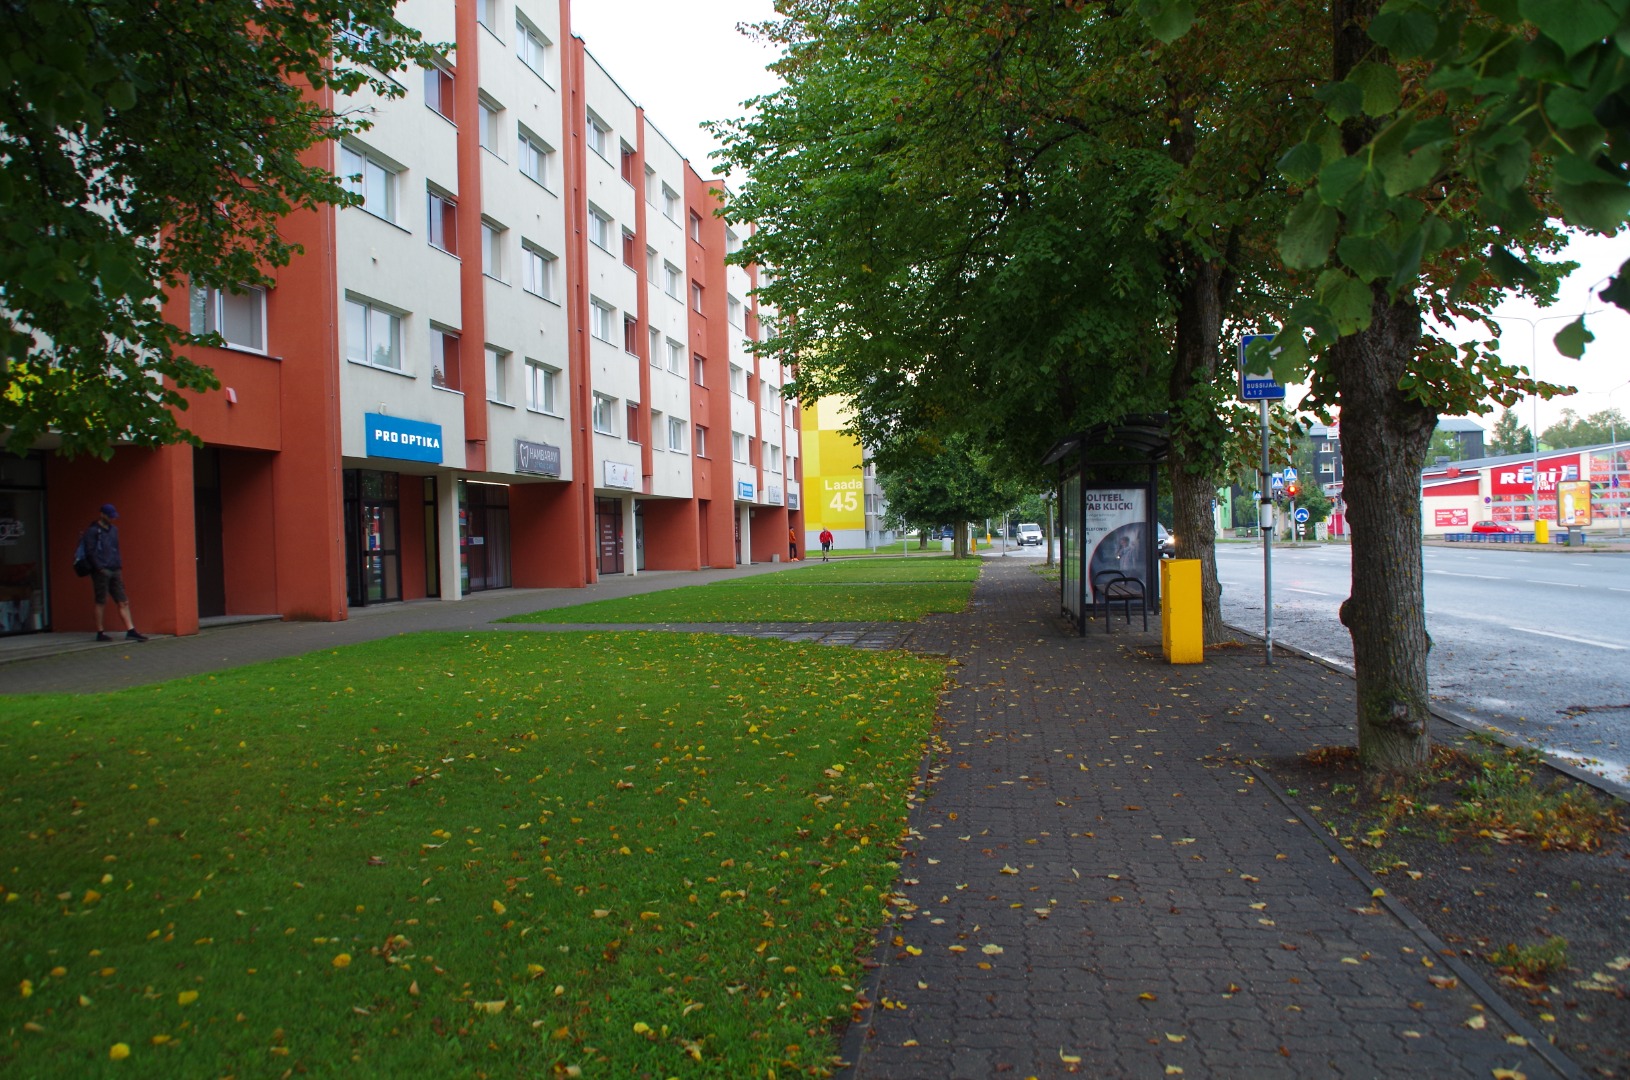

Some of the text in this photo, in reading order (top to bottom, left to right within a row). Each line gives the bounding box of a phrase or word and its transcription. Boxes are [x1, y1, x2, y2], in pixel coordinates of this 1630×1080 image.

[375, 429, 440, 449] PRO OPTIKA
[824, 479, 863, 491] Laada
[829, 491, 858, 512] 45
[1103, 502, 1133, 511] KLICK!
